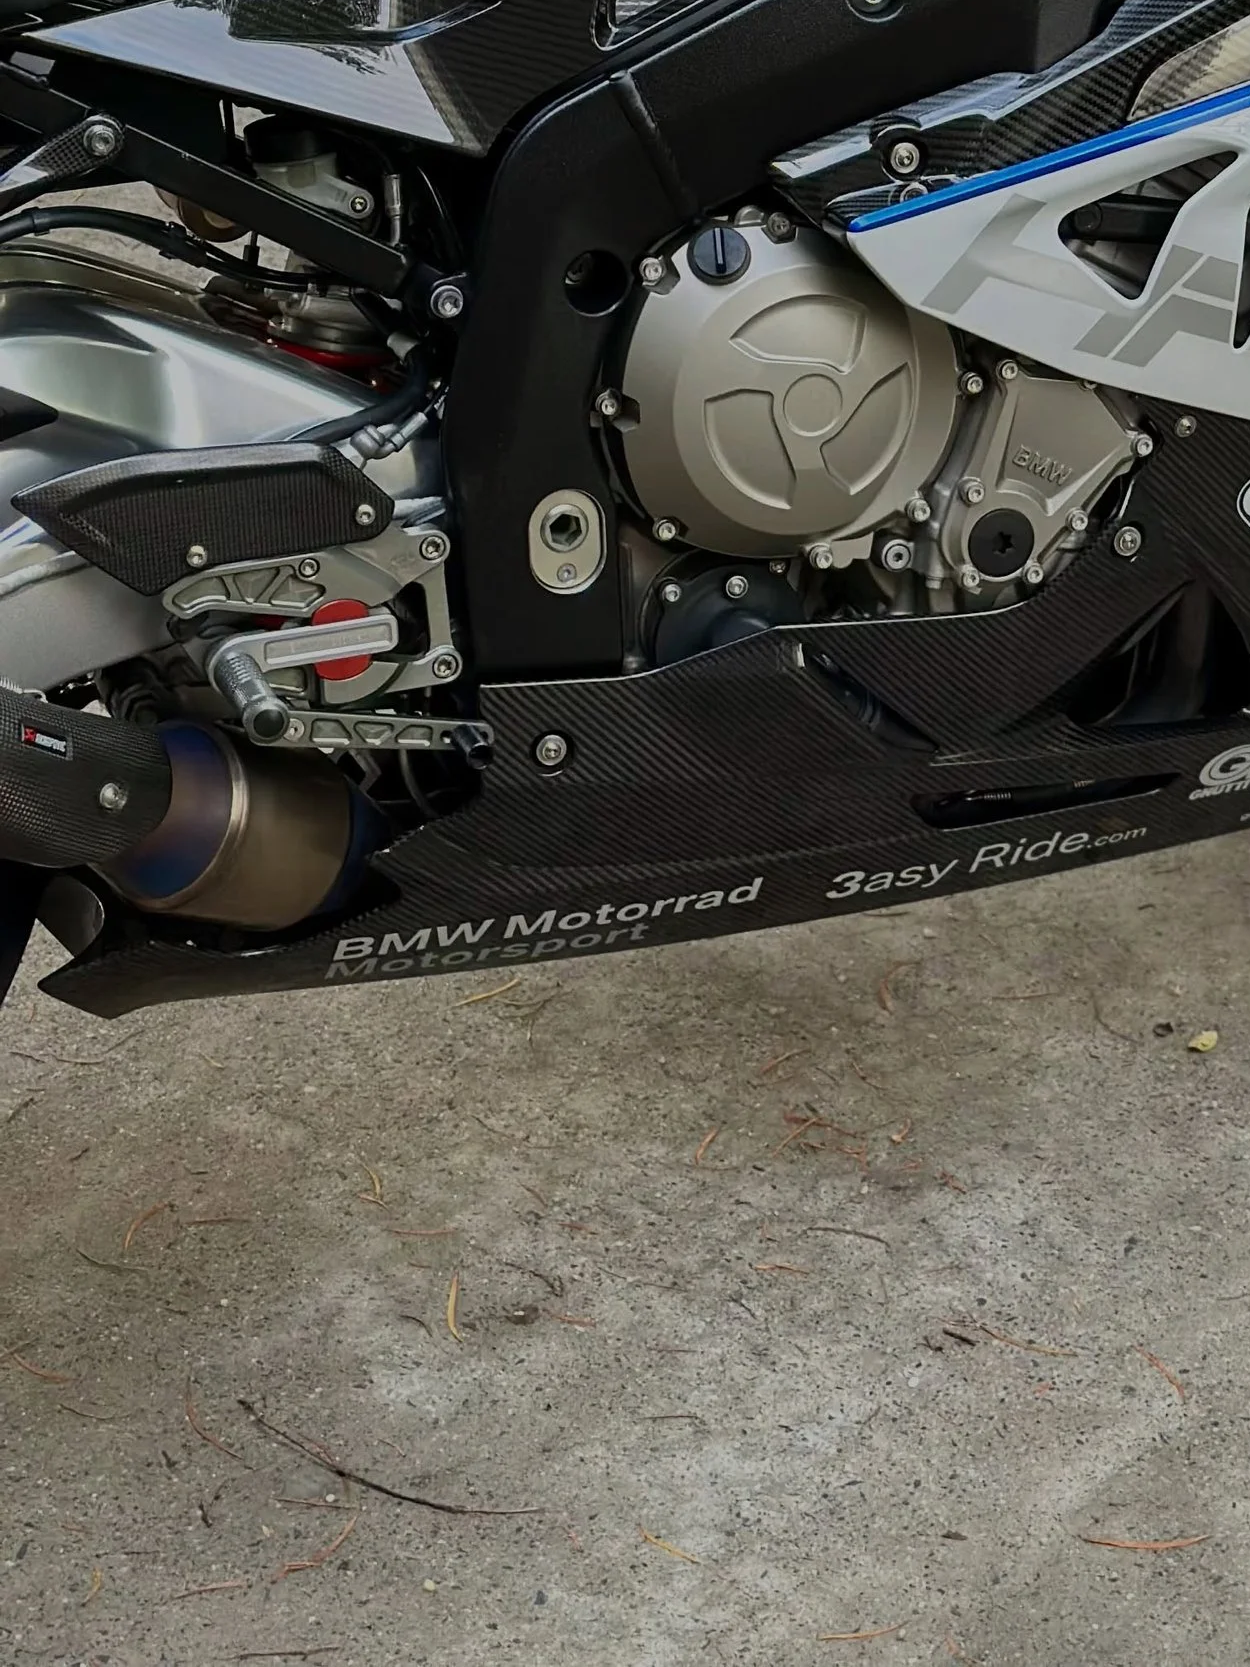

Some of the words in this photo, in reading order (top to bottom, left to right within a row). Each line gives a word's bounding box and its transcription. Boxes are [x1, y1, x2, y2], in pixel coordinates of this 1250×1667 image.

[1012, 444, 1074, 486] BMW
[332, 918, 495, 962] BMW
[503, 877, 765, 940] Motorrad
[324, 921, 650, 980] Motorsport
